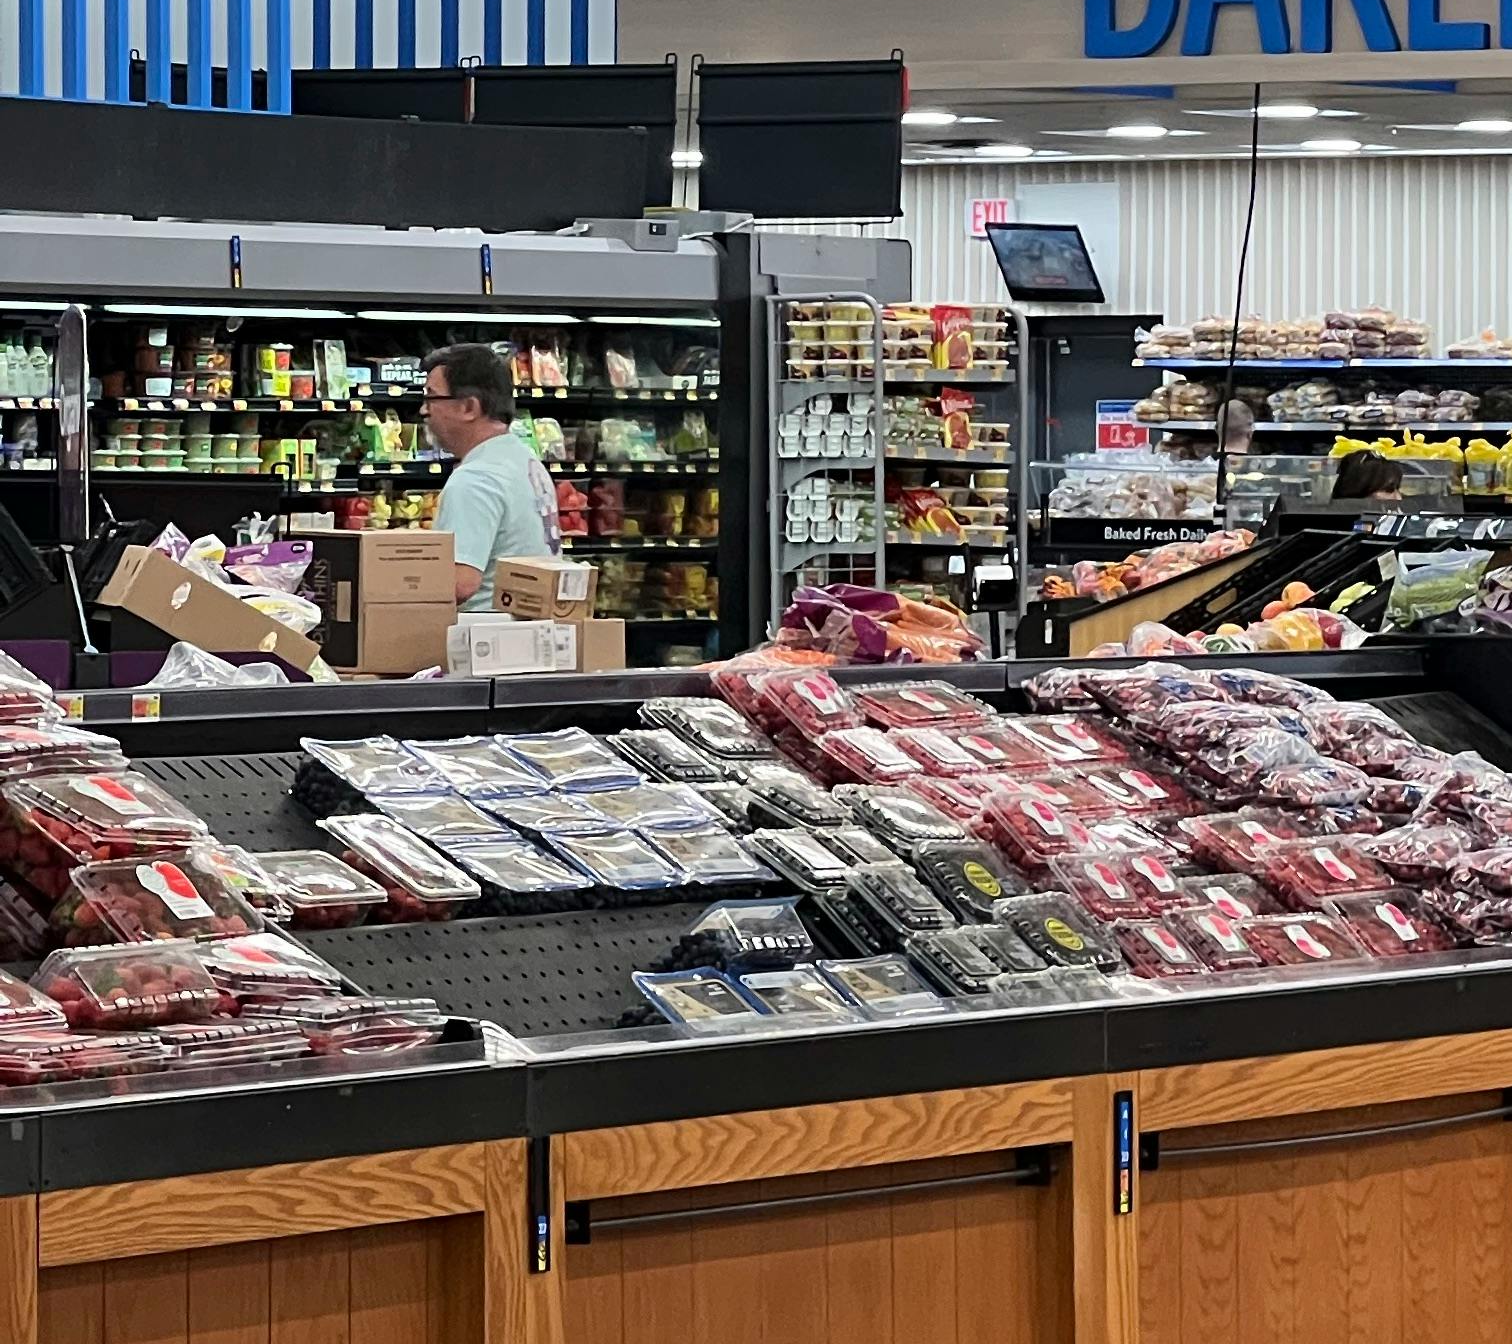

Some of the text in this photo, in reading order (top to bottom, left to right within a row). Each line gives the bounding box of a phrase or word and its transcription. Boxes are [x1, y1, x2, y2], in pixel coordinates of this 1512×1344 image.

[972, 200, 1008, 233] EXIT
[1104, 526, 1141, 540] Baked
[1144, 527, 1177, 541] Fresh
